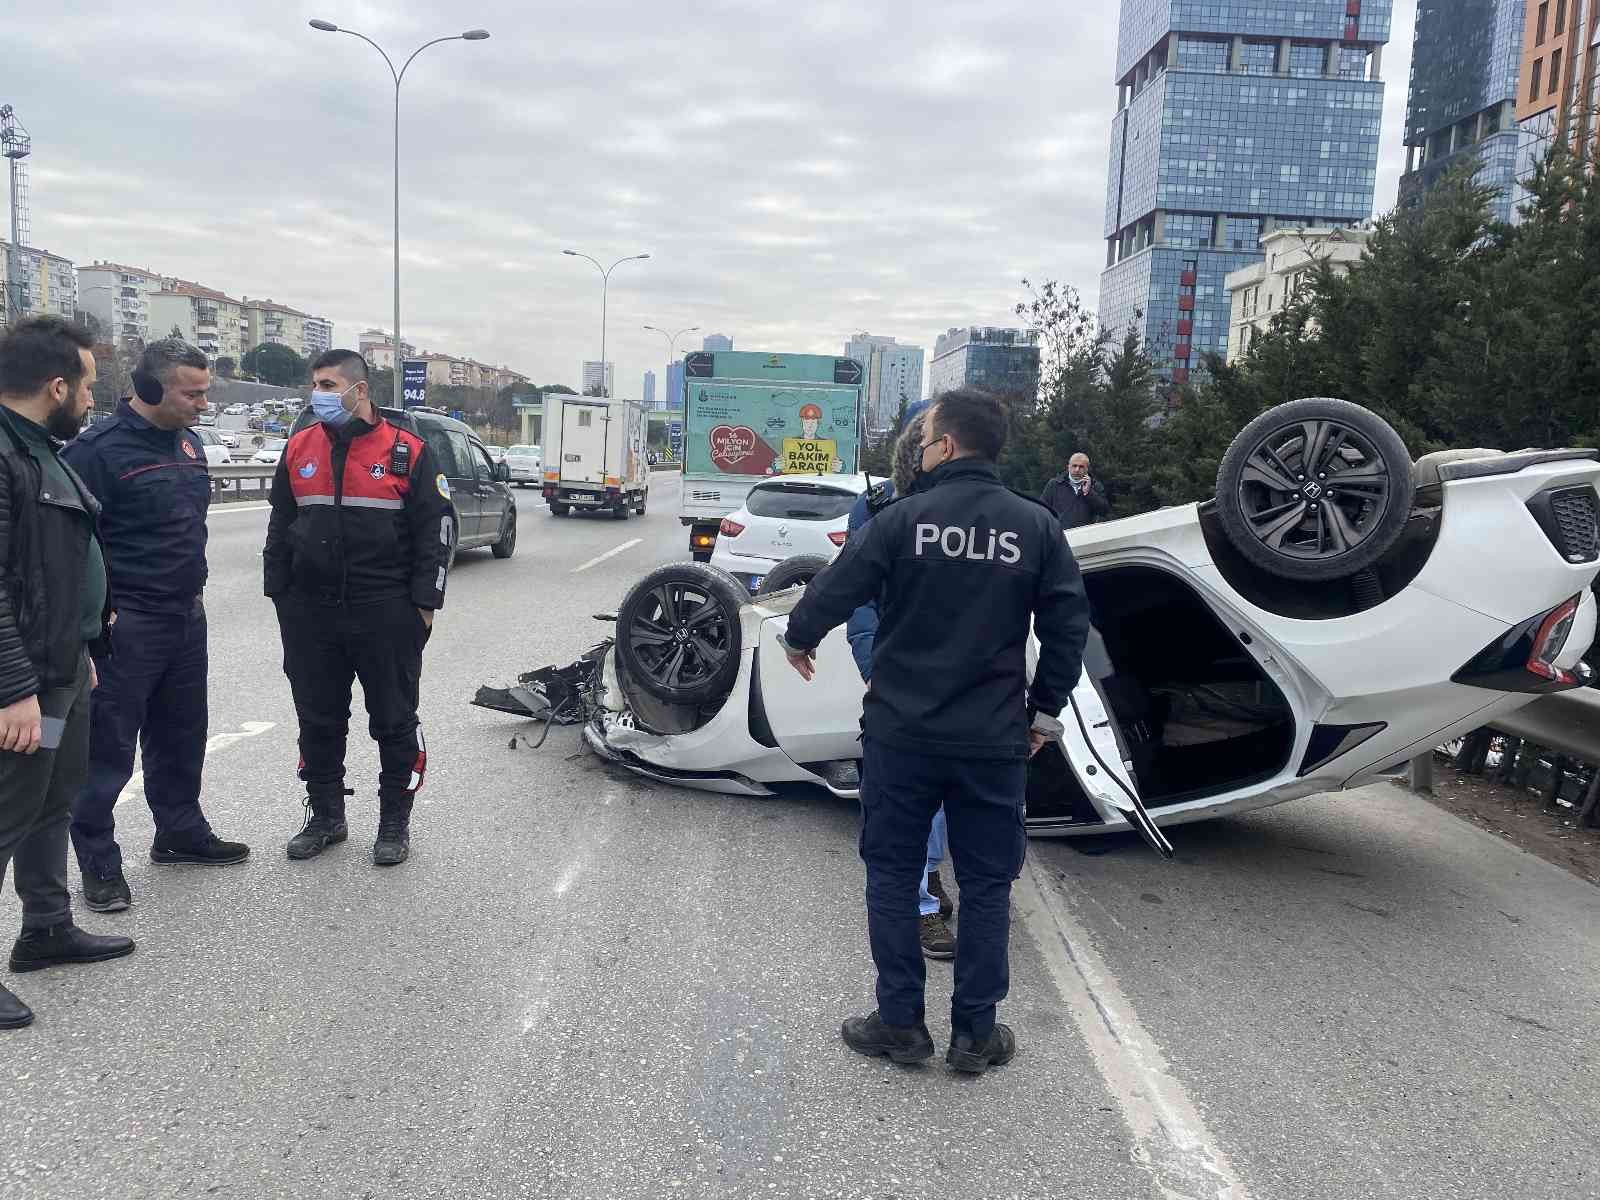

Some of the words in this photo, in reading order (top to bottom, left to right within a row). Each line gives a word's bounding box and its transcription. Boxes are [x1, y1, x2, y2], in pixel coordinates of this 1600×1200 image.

[404, 389, 425, 400] 94.8
[797, 442, 823, 452] YOL
[788, 451, 830, 462] BAKIM
[788, 461, 829, 472] ARACI
